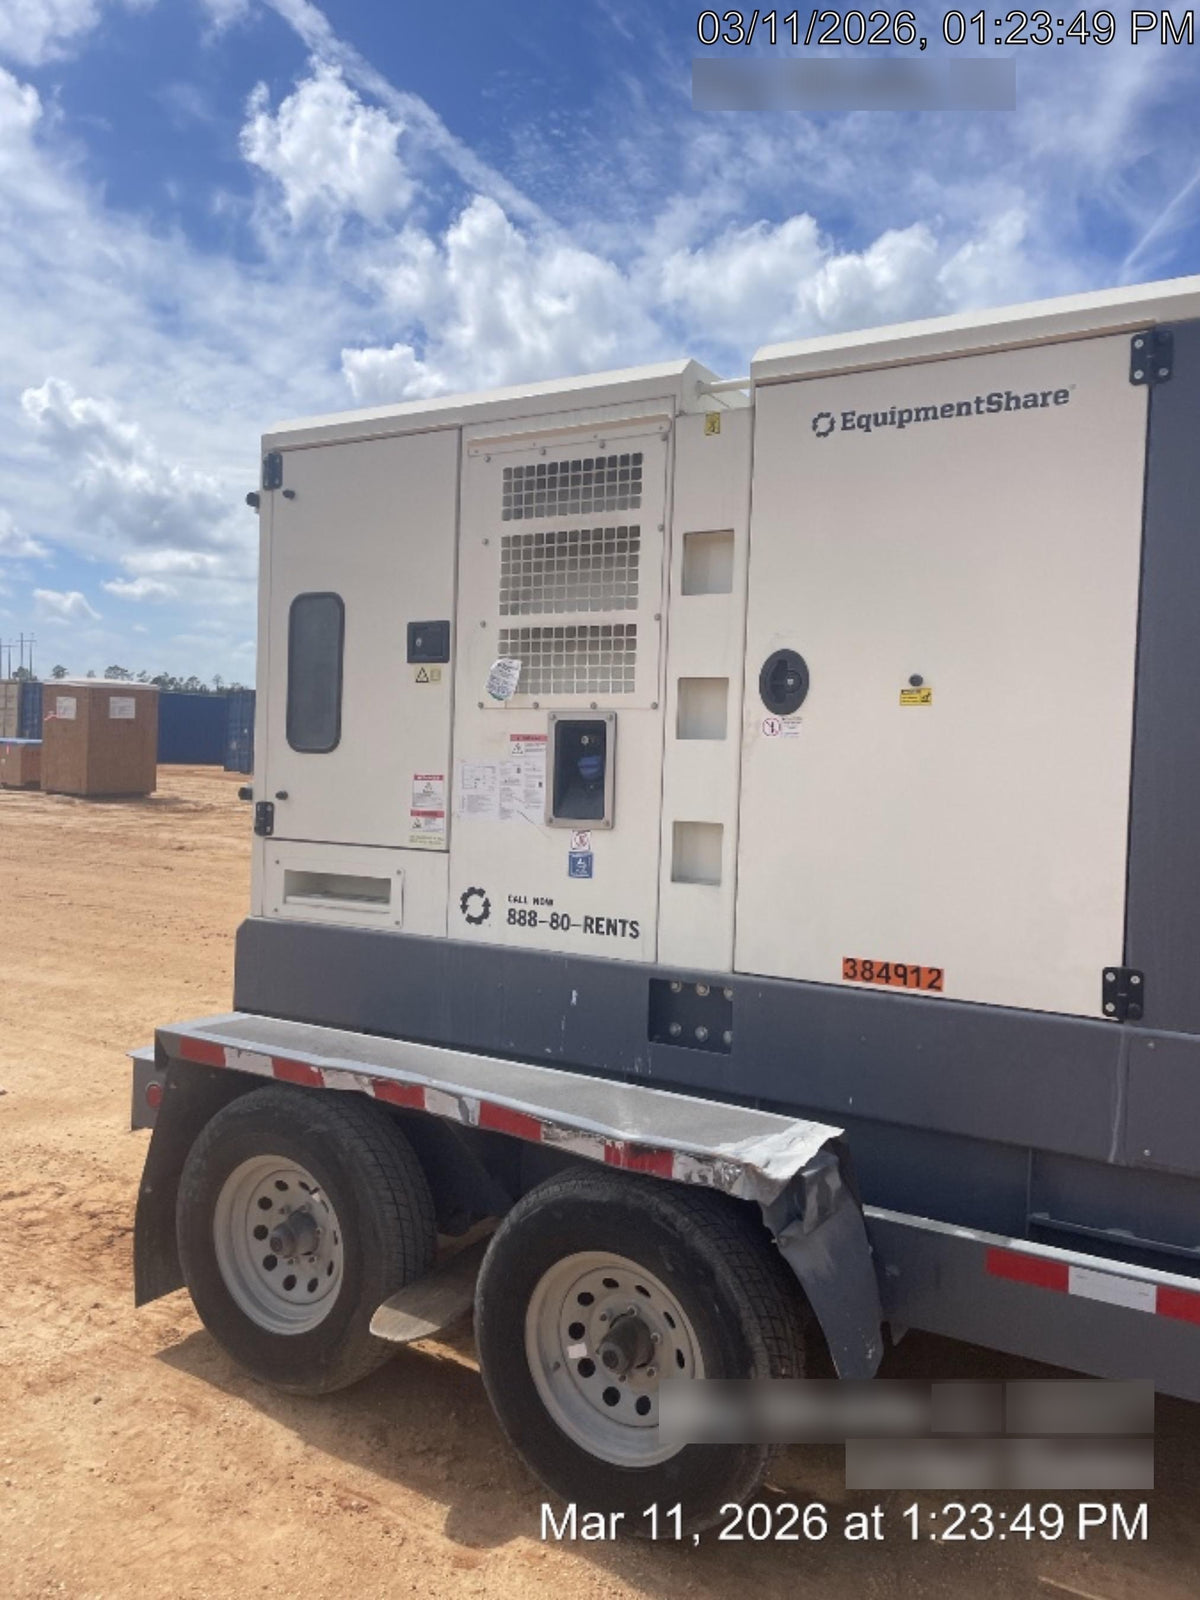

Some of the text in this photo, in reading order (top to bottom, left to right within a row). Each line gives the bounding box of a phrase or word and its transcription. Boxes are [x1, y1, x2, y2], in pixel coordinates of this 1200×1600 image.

[840, 387, 1071, 433] EquipmentShare
[507, 894, 554, 907] CALL NOW
[507, 908, 640, 939] 888-80-RENTS
[844, 957, 943, 991] 384912
